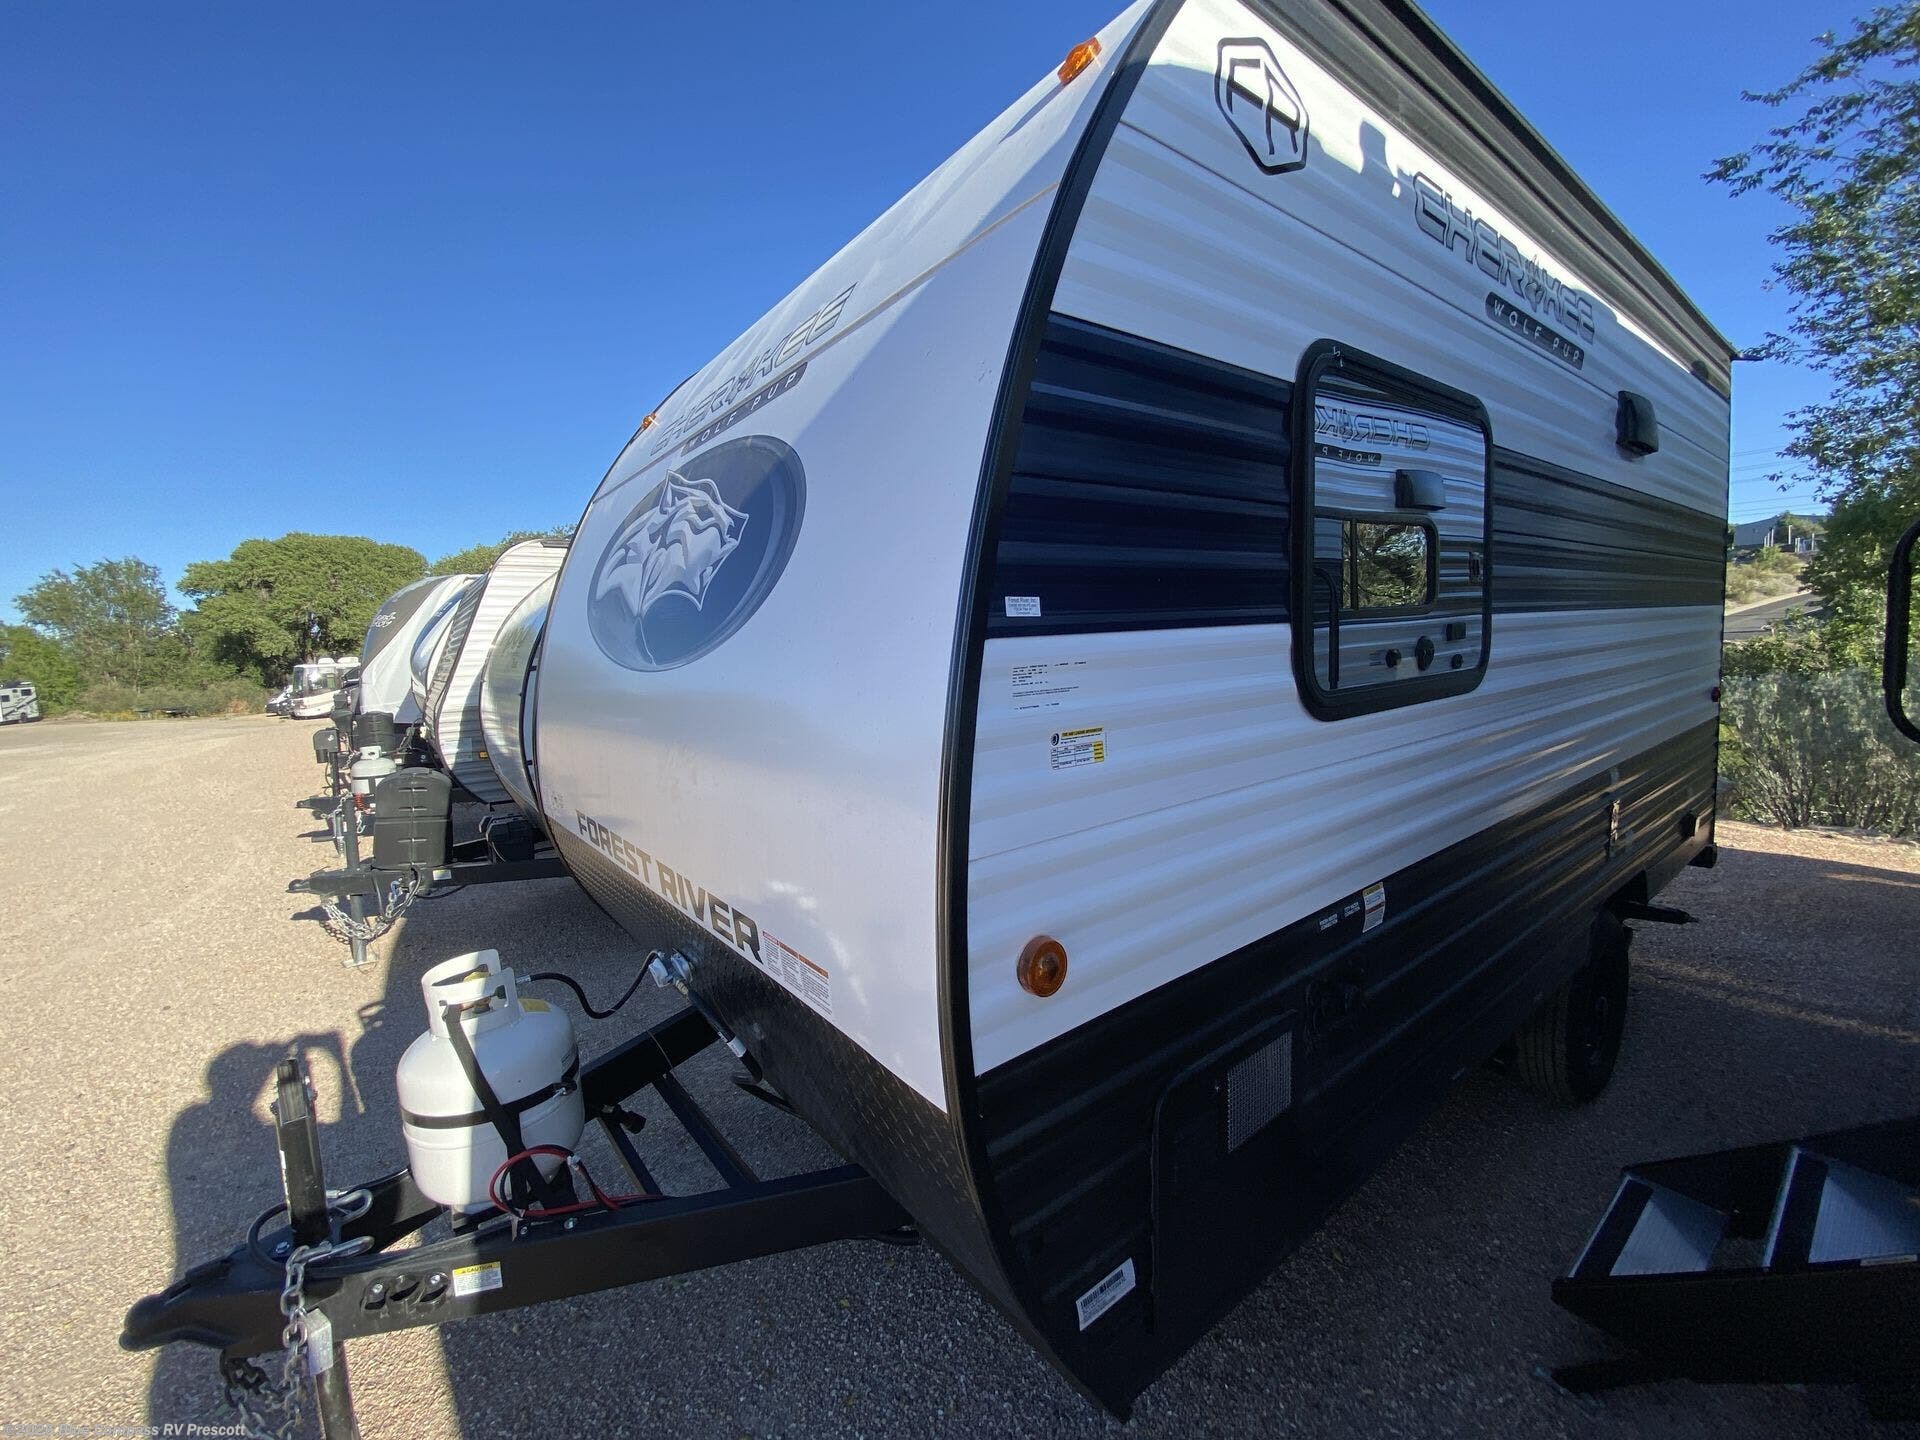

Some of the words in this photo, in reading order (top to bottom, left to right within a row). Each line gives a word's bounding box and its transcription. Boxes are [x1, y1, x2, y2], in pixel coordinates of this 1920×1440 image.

[1493, 299, 1543, 340] WOLF
[1552, 337, 1583, 362] PUP
[688, 410, 737, 448] WOLF
[750, 371, 798, 411] PUP
[576, 810, 651, 884] FOREST
[656, 859, 764, 965] RIVER
[466, 1264, 493, 1273] CAUTION
